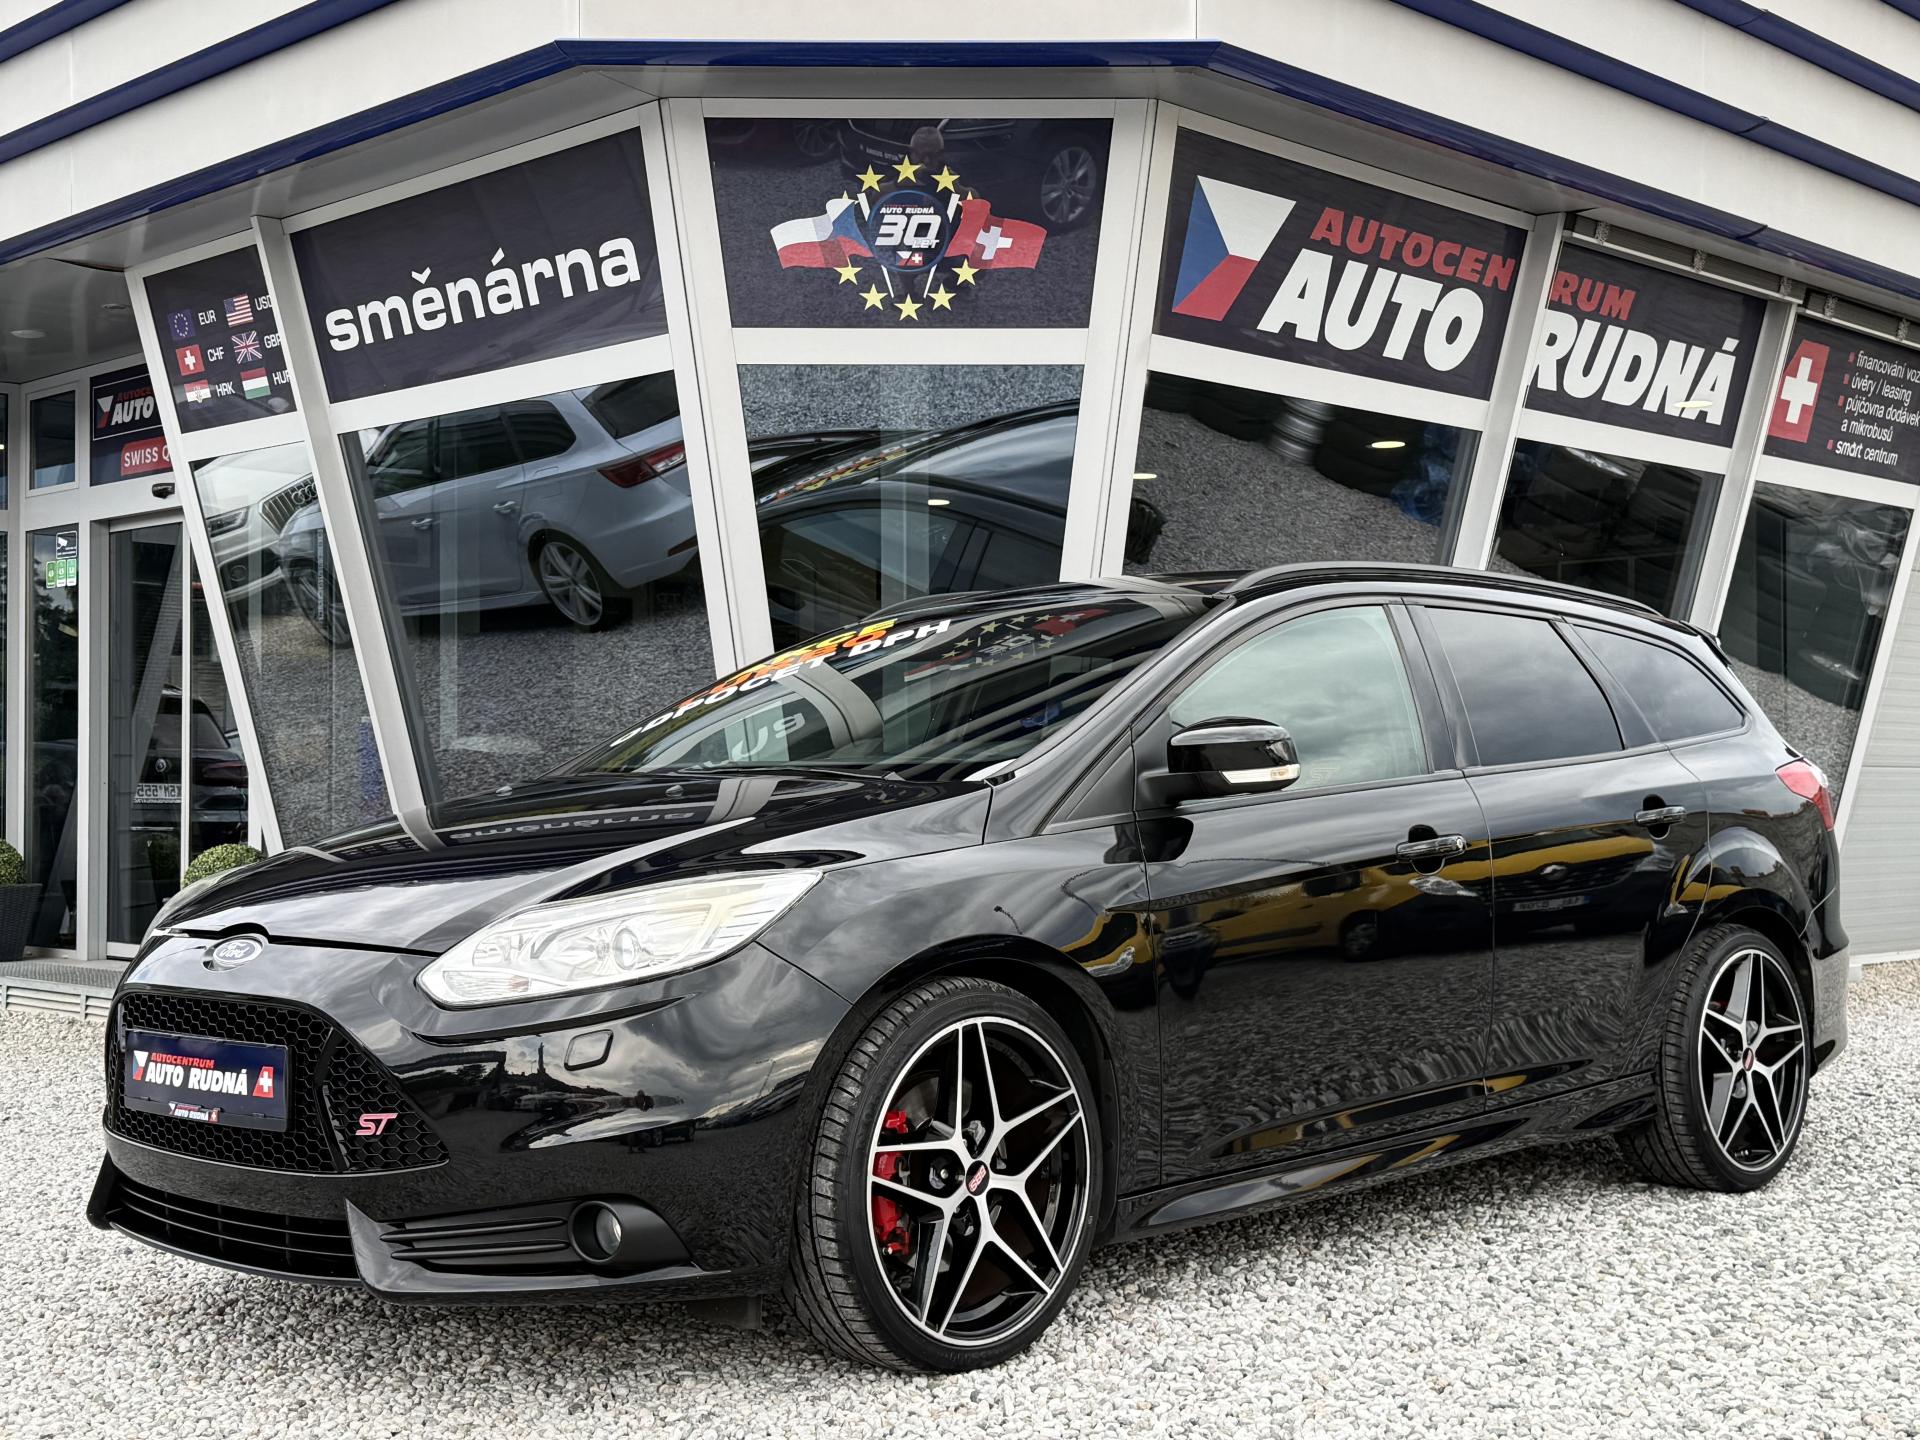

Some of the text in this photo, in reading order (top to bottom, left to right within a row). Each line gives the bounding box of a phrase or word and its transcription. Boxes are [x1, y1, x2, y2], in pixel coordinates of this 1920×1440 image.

[905, 206, 934, 214] RUDNÁ
[875, 214, 942, 246] 30
[911, 239, 940, 249] LET
[1310, 206, 1516, 292] AUTOCEN
[324, 237, 641, 351] směnárna
[198, 309, 217, 326] EUR
[1256, 247, 1740, 425] AUTO RUDNÁ
[207, 346, 225, 362] CHF
[1856, 350, 1907, 380] financování
[216, 381, 236, 397] HRK
[1851, 372, 1877, 397] úvěry
[1881, 379, 1912, 407] leasing
[110, 395, 155, 426] AUTO
[1841, 418, 1848, 432] a
[124, 446, 159, 467] SWISS
[1863, 447, 1899, 466] centrum
[848, 619, 952, 658] DPH
[218, 941, 251, 959] Ford
[150, 1052, 215, 1069] AUTOCENTRUM
[145, 1062, 248, 1096] AUTO RUDNÁ
[355, 1112, 399, 1136] ST
